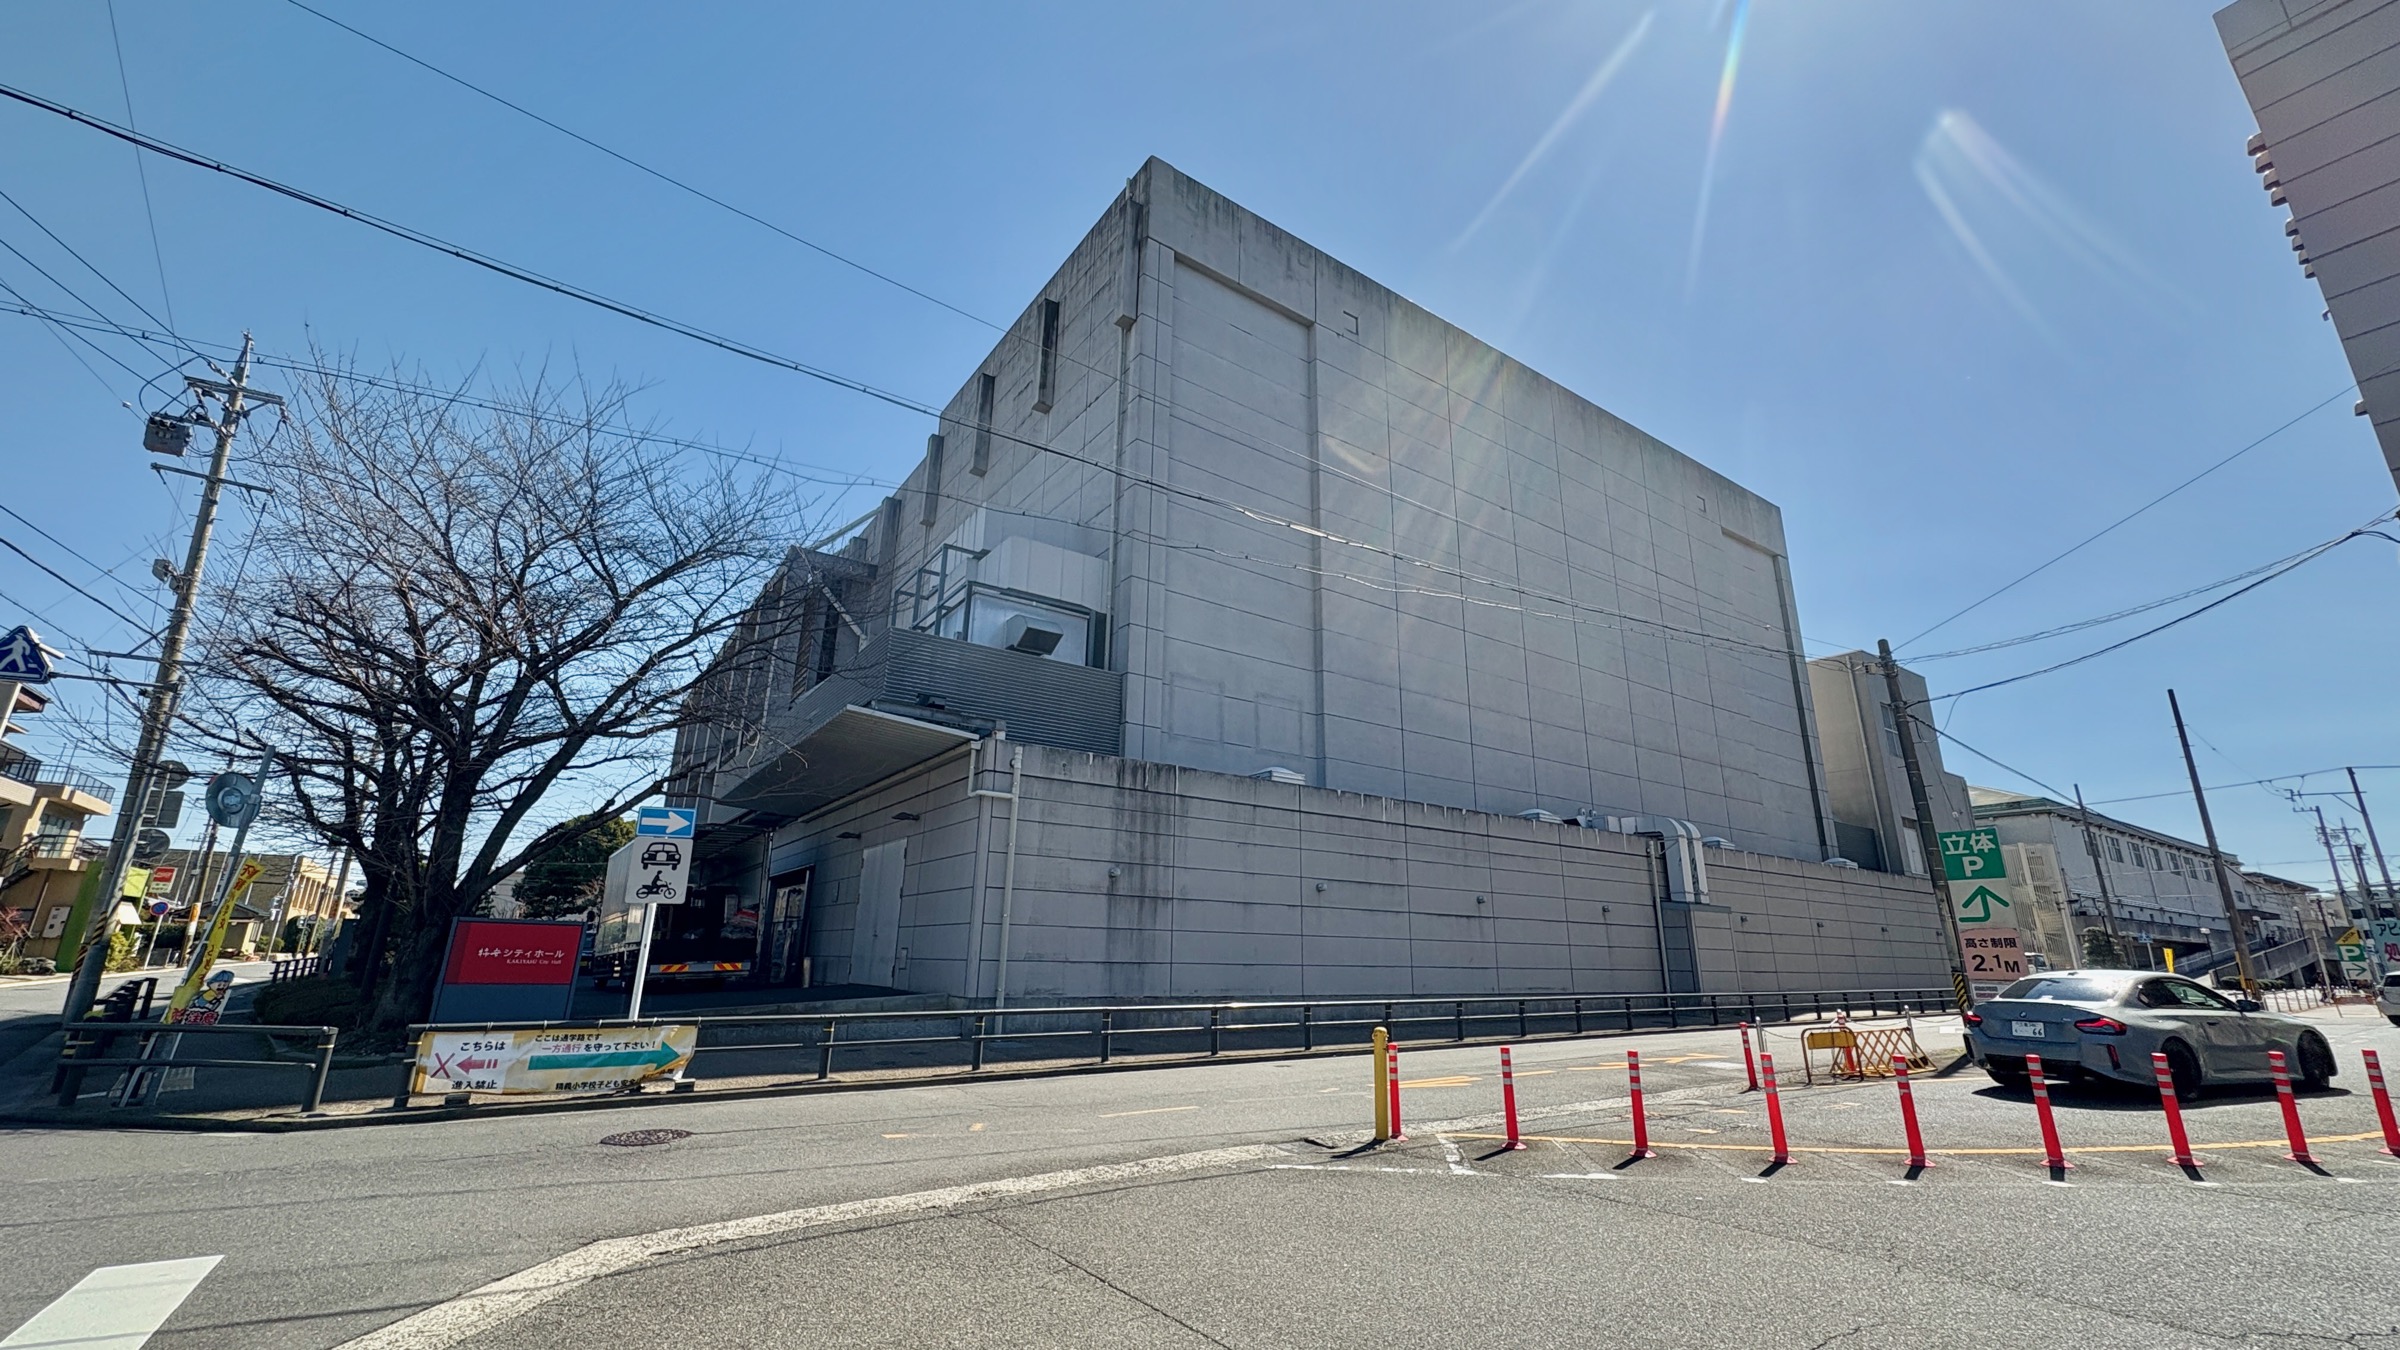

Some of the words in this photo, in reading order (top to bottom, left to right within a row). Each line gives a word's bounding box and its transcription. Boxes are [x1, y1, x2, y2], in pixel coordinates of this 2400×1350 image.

[1943, 831, 1996, 855] 立体
[1962, 855, 1985, 878] P
[1963, 937, 2018, 949] 高さ制限
[2339, 945, 2361, 961] P
[534, 1033, 602, 1043] ここは通学路です
[460, 1040, 506, 1052] こちらは
[451, 1079, 498, 1090] 進入禁止
